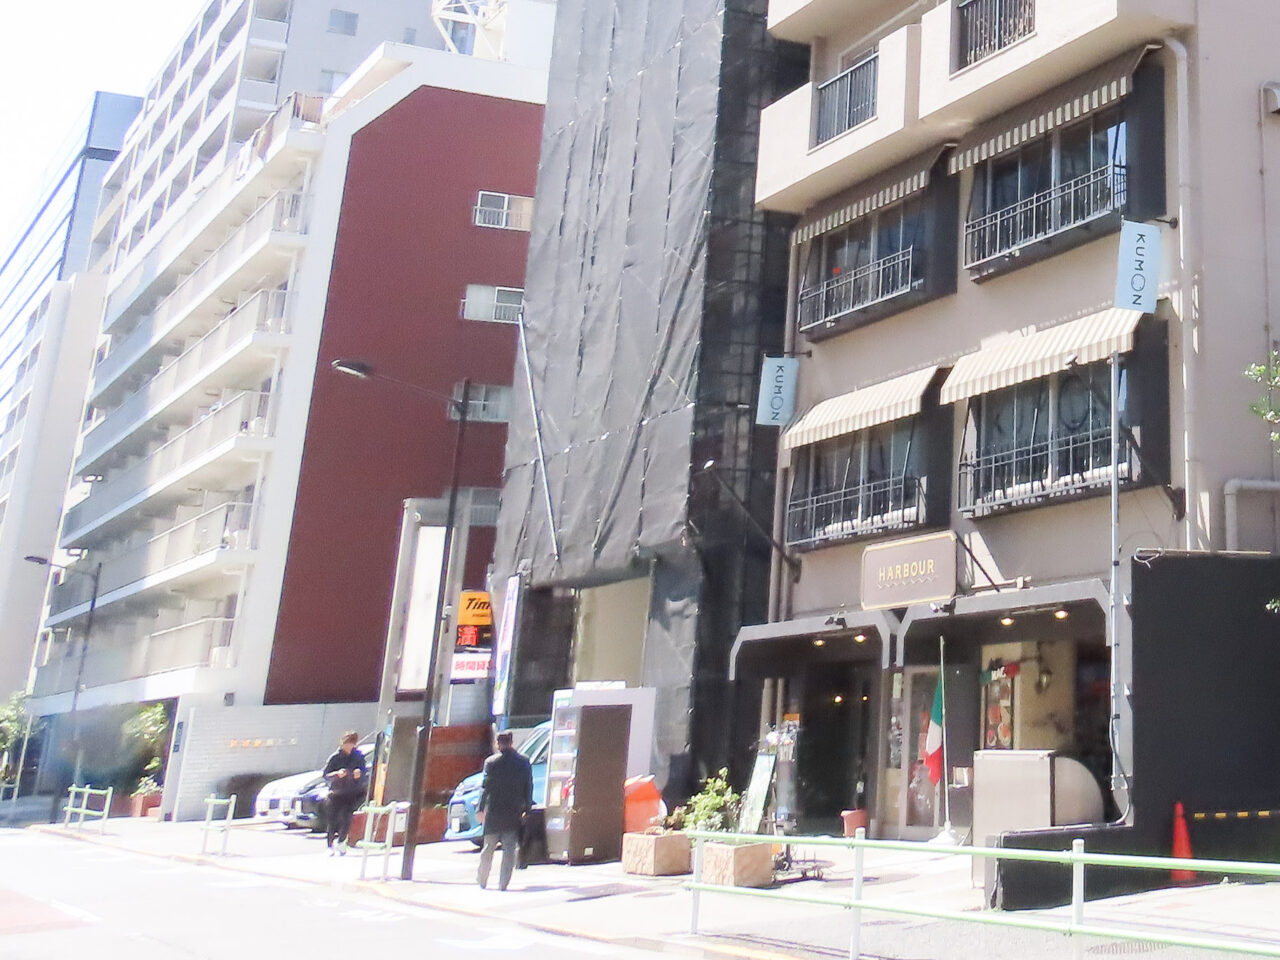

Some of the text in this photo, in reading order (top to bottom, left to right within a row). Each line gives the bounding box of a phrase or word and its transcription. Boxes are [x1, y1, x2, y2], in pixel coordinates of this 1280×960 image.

[1130, 233, 1147, 306] KUMON
[770, 365, 785, 421] KUMON
[878, 559, 936, 581] HARBOUR
